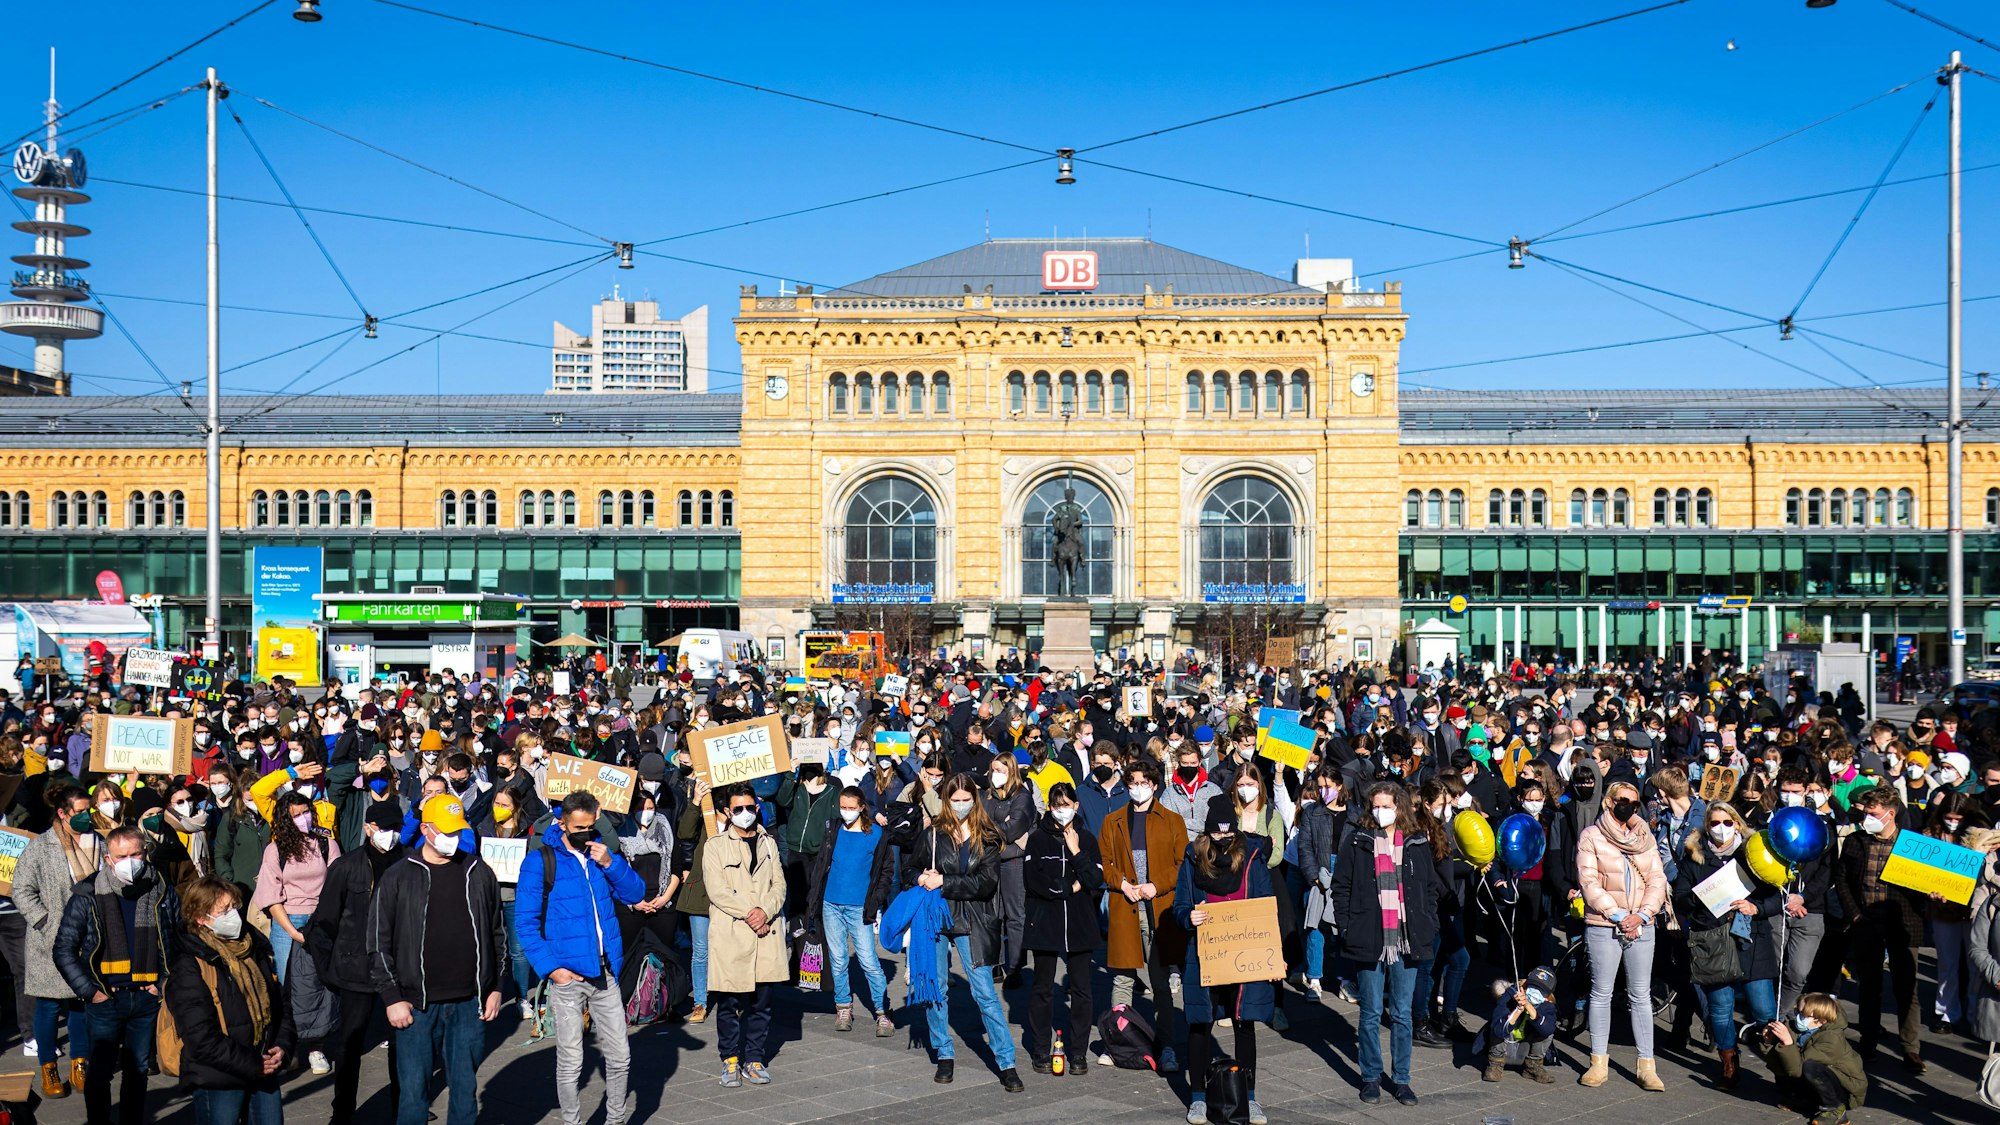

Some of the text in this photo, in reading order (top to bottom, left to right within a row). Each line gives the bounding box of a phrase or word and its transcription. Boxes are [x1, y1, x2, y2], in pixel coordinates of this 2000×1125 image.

[1051, 258, 1091, 283] DB
[1701, 596, 1724, 605] Reise
[362, 603, 441, 616] Fahrkarten
[181, 658, 215, 668] SAVE
[187, 676, 213, 685] THE
[887, 675, 899, 684] NO
[170, 690, 222, 702] PLANET
[887, 685, 905, 695] WAR
[117, 725, 166, 746] PEACE
[1282, 723, 1311, 742] STAND
[713, 729, 767, 752] PEACE
[113, 750, 163, 766] NOT WAR
[732, 749, 747, 760] for
[1266, 746, 1303, 764] UKRAINE
[554, 758, 583, 776] WE
[713, 753, 775, 783] UKRAINE
[599, 768, 629, 788] stand
[548, 781, 570, 793] with
[1901, 838, 1979, 875] STOP WAR
[1221, 908, 1240, 923] viel
[1200, 925, 1271, 945] Menschenleben
[801, 952, 822, 966] HIGH
[1204, 949, 1228, 961] kostet
